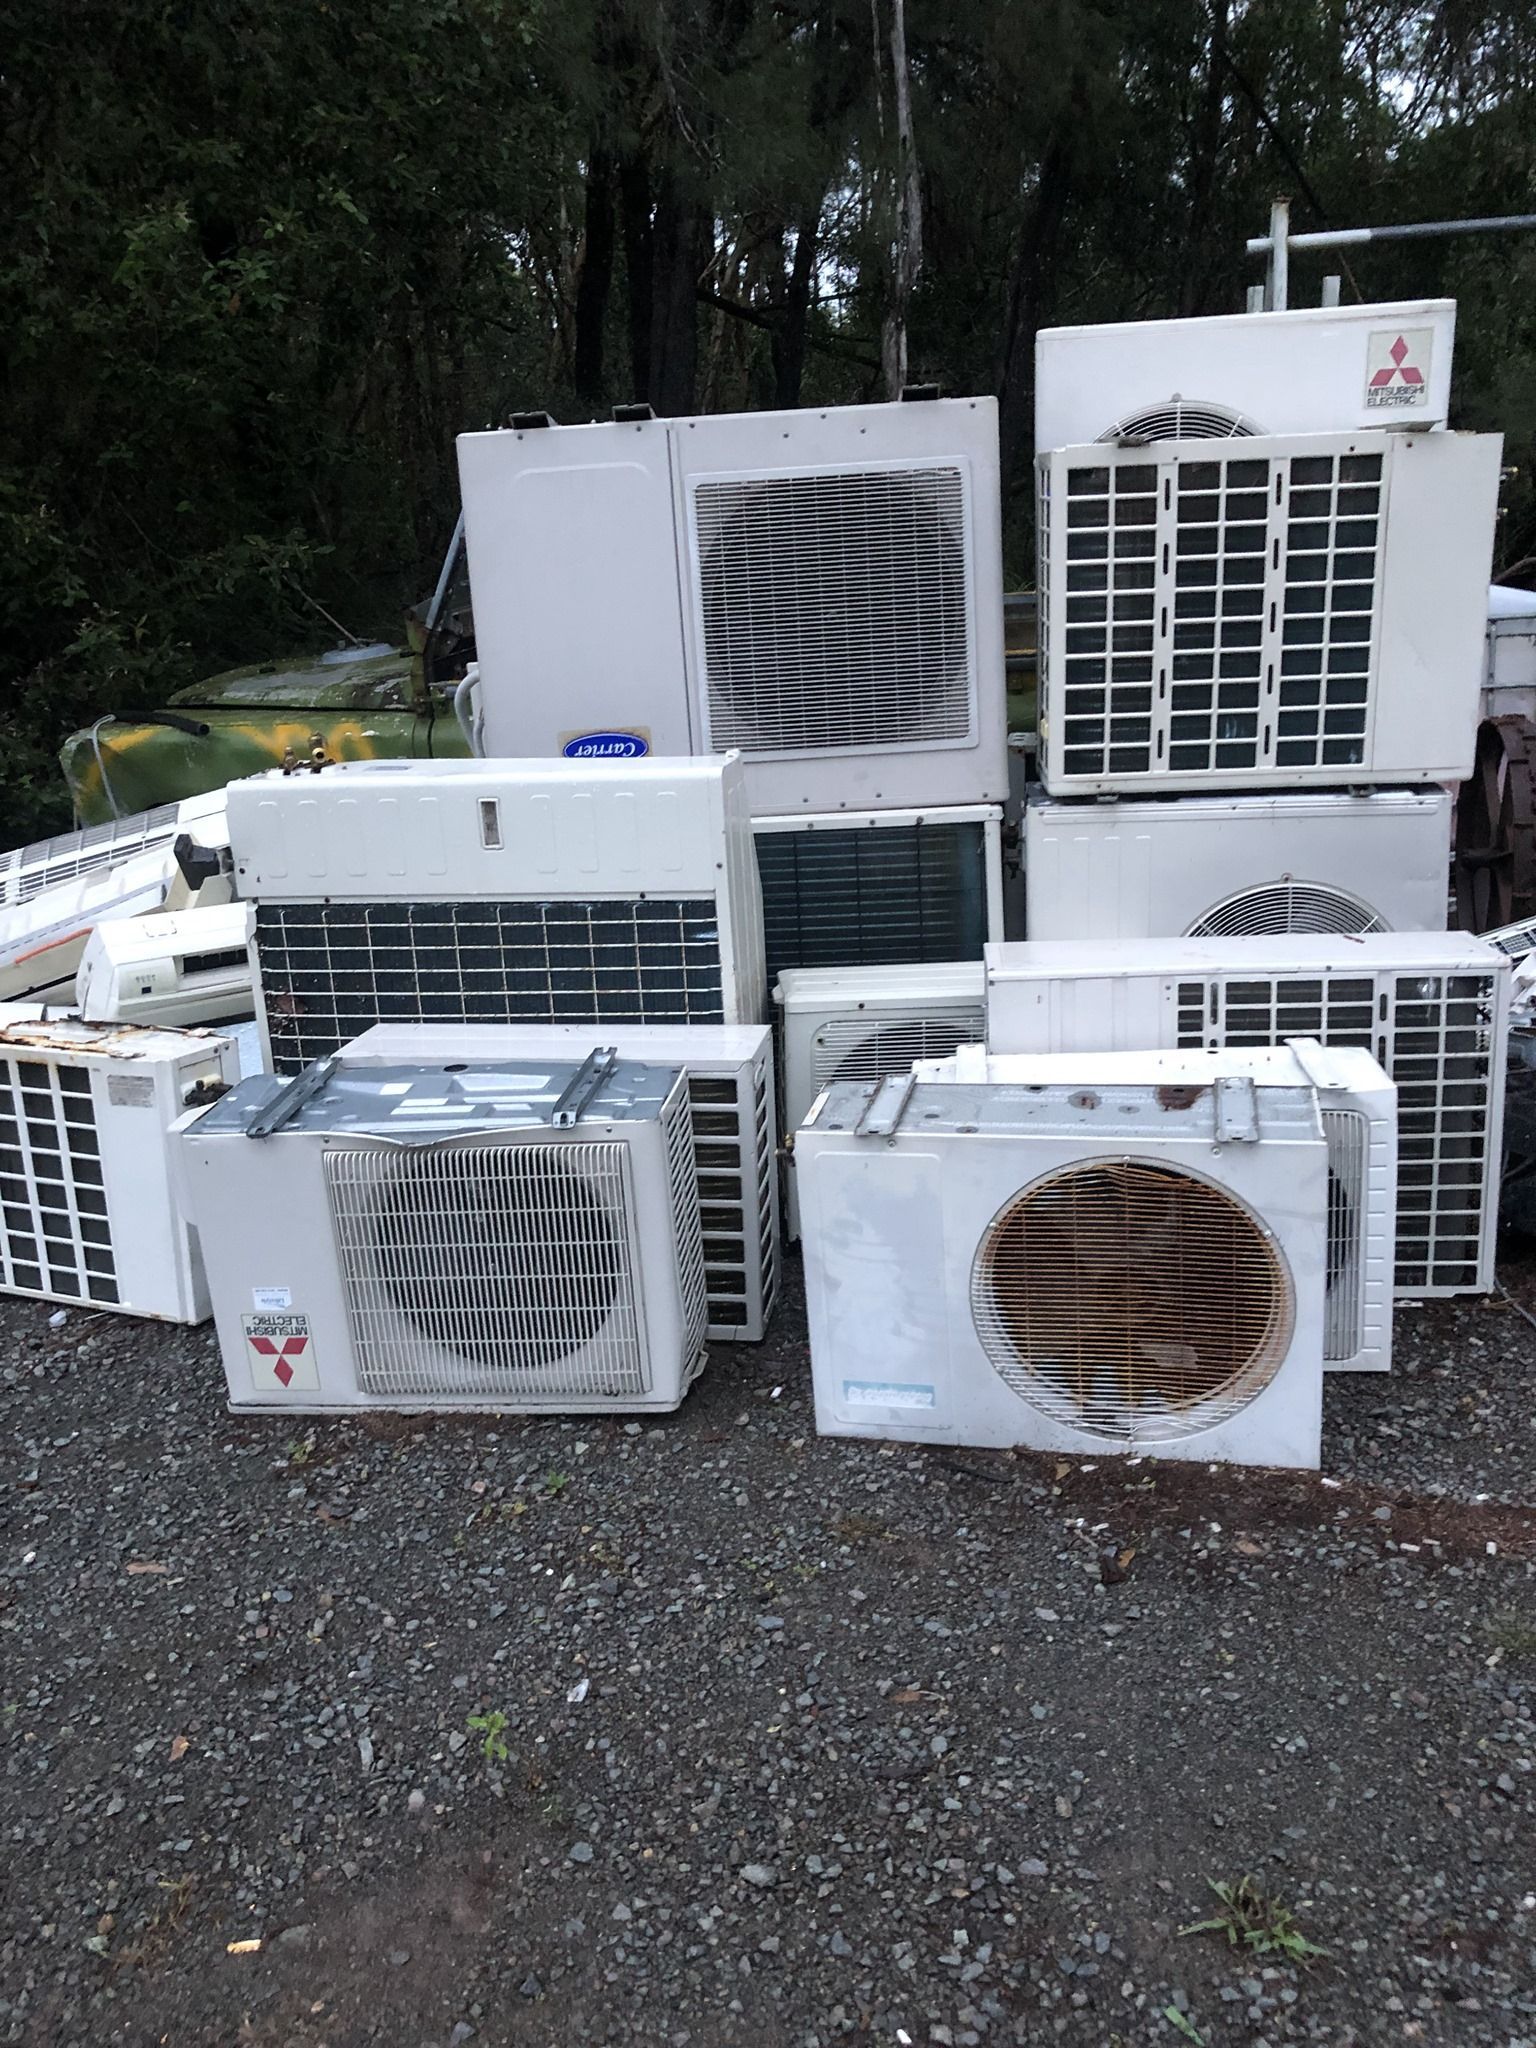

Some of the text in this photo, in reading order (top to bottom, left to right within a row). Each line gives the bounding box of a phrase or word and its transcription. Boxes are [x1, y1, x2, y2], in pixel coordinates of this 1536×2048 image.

[1368, 385, 1424, 397] MITSUBISHI
[1367, 396, 1416, 406] ELECTRIC
[574, 742, 636, 757] Carrier
[252, 1316, 306, 1326] ELECTRIC
[246, 1326, 308, 1336] MITSUBISHI
